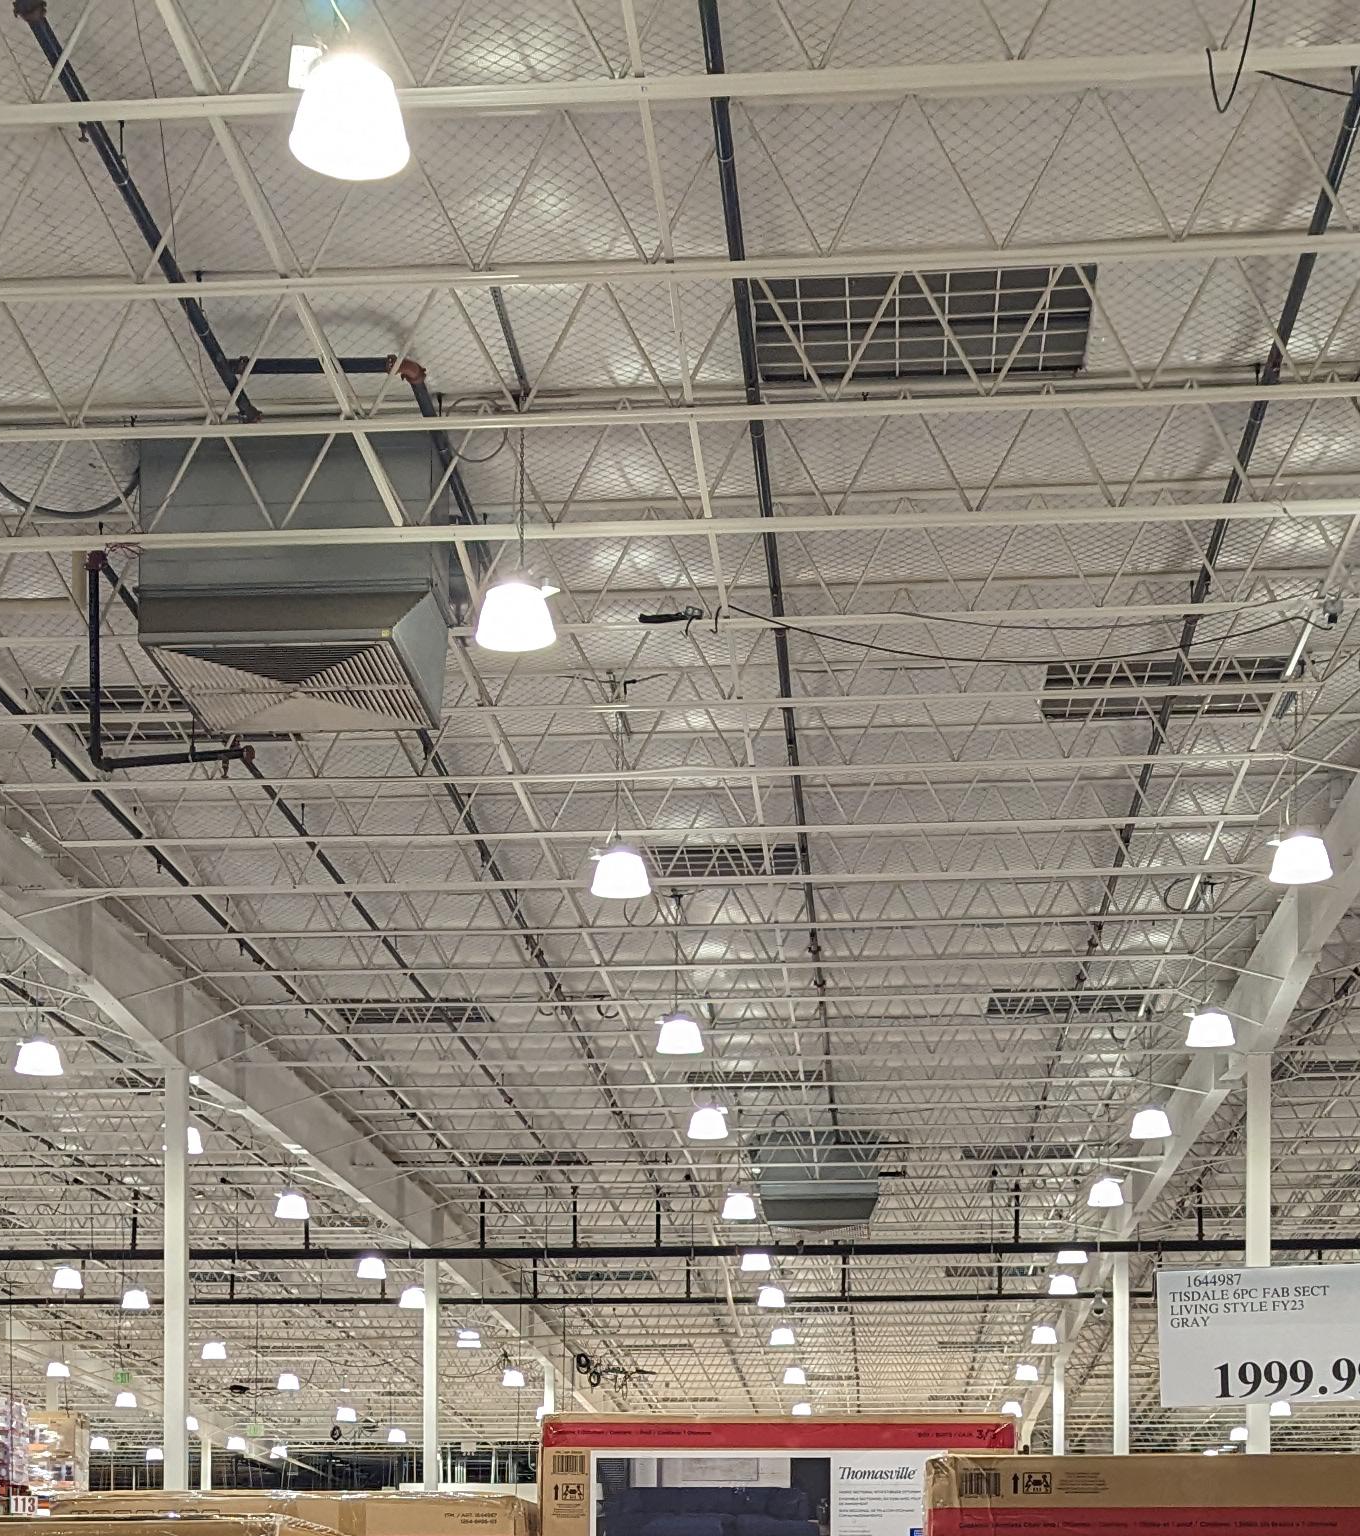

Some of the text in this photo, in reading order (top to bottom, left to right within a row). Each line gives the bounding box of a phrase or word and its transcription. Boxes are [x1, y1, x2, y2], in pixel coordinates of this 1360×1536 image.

[1186, 1274, 1242, 1288] 1644987
[1169, 1285, 1330, 1303] TISDALE 6PC FAB SECT
[1170, 1300, 1305, 1316] LIVING STYLE FY23
[1170, 1316, 1210, 1329] GRAY
[839, 1466, 917, 1480] Thomasville
[14, 1497, 36, 1514] 113
